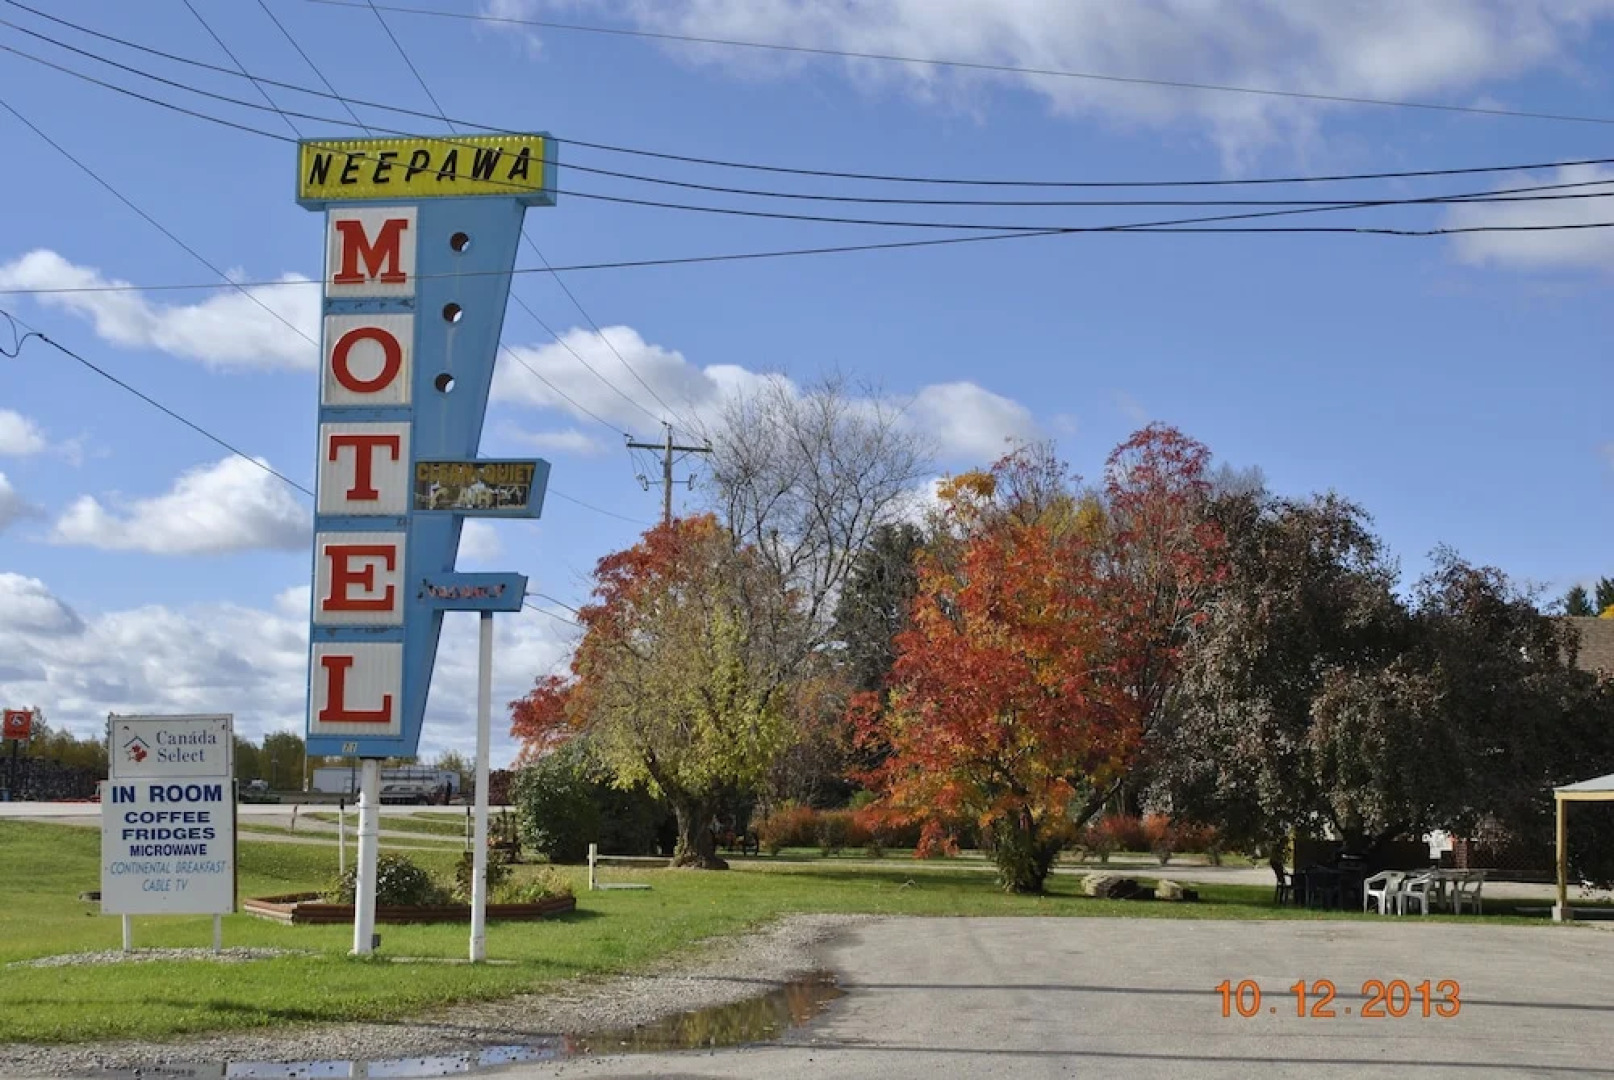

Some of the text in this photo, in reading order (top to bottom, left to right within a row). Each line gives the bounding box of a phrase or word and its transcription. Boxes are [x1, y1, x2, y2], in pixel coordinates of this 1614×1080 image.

[309, 147, 530, 185] NEEPAWA
[319, 219, 409, 723] MOTEL
[156, 730, 217, 745] Canada
[157, 747, 206, 763] Select
[112, 784, 222, 803] IN ROOM
[124, 811, 210, 824] COFFEE
[122, 827, 216, 841] FRIDGES
[129, 843, 208, 857] MICROWAVE
[109, 861, 227, 876] CONTINENTAL BREAKFAST
[142, 879, 189, 892] CABLE TV
